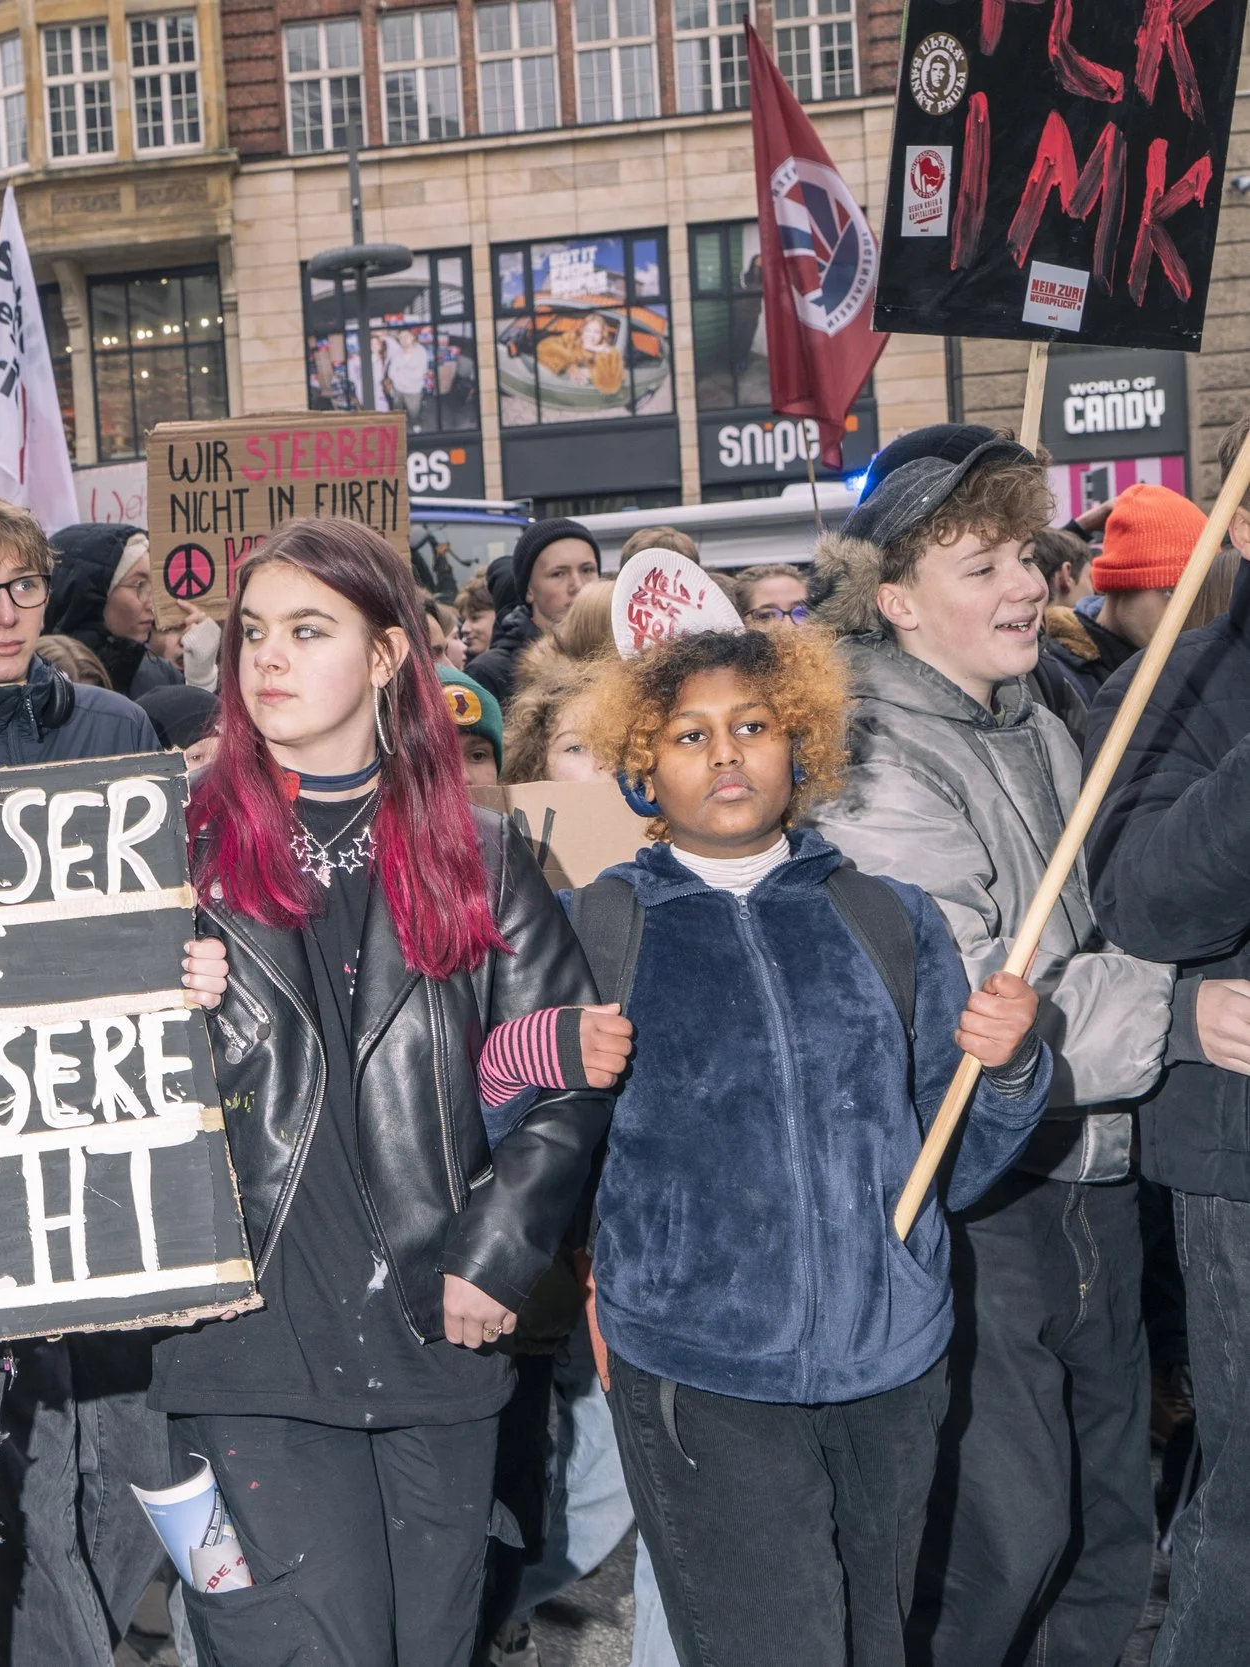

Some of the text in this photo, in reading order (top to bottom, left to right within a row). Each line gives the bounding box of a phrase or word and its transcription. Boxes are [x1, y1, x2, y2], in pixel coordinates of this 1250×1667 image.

[1031, 278, 1057, 294] NEIN
[1069, 376, 1157, 397] WORLD OF
[1063, 388, 1166, 435] CANDY
[168, 425, 399, 483] WIR STERBEN
[718, 417, 822, 472] snipe
[170, 487, 249, 534] NICHT
[268, 485, 295, 530] IN
